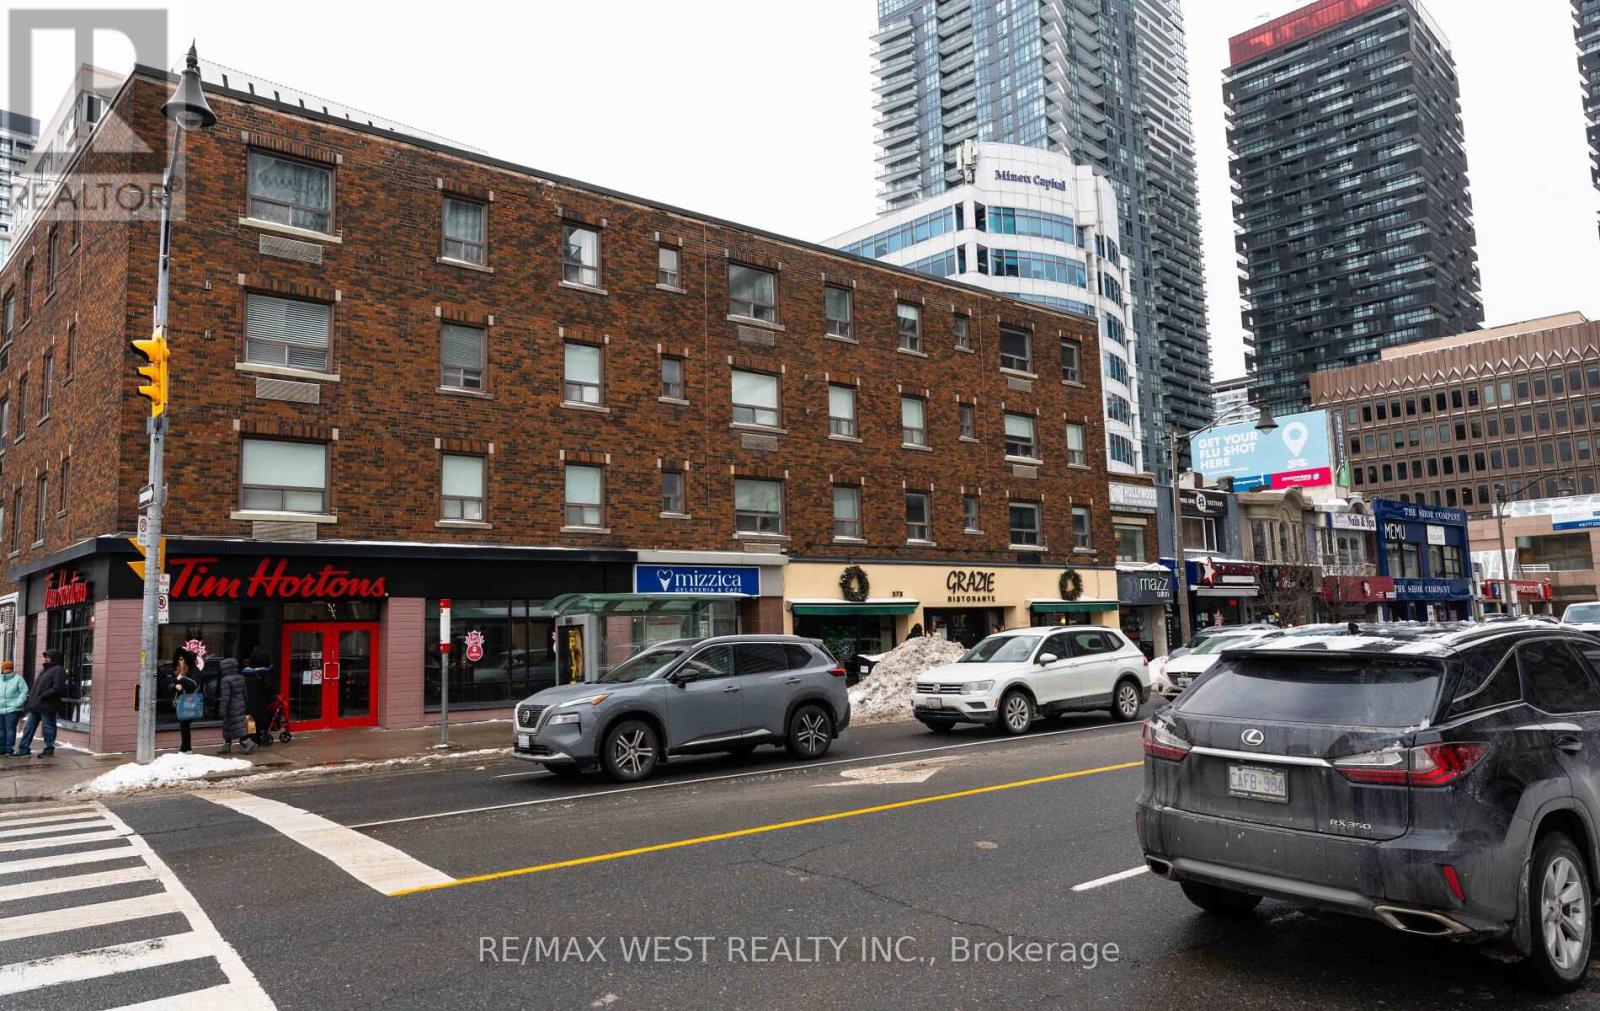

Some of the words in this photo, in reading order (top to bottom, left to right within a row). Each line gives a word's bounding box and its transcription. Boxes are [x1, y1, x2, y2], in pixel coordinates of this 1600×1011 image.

[995, 169, 1031, 184] Minett
[1033, 175, 1066, 191] Capital
[1198, 437, 1220, 449] GET
[1223, 431, 1258, 445] YOUR
[1199, 447, 1220, 459] FLU
[1223, 443, 1256, 456] SHOT
[1200, 457, 1231, 470] HERE
[1403, 507, 1418, 517] THE
[1419, 509, 1434, 519] SHOE
[1435, 511, 1462, 521] COMPANY
[1384, 523, 1406, 540] MEMU
[168, 556, 242, 598] Tim
[247, 556, 387, 598] Hortons
[675, 570, 742, 587] mizzica
[946, 570, 996, 594] GRAZIE
[1139, 577, 1169, 592] mazz
[1156, 590, 1170, 598] salon
[1407, 584, 1423, 594] SHOE
[1424, 585, 1451, 594] COMPANY
